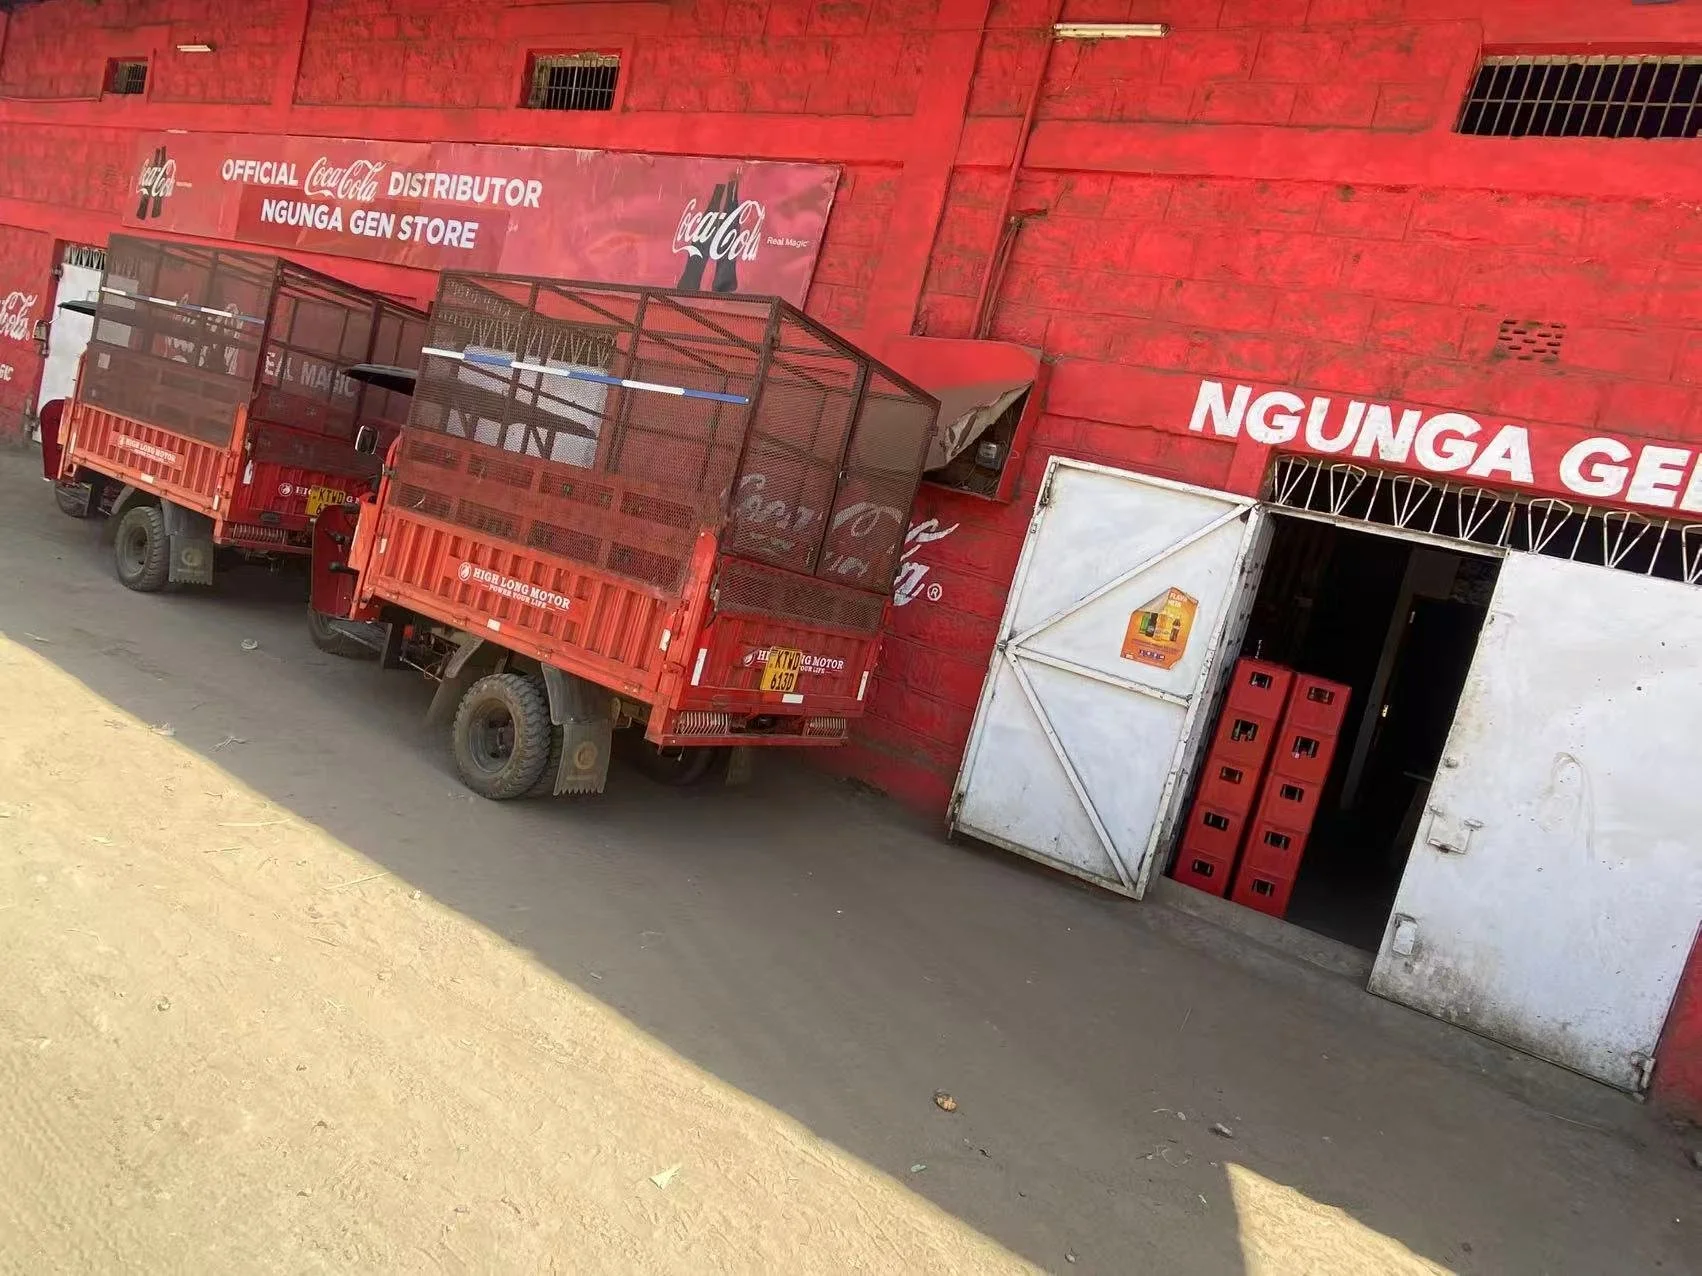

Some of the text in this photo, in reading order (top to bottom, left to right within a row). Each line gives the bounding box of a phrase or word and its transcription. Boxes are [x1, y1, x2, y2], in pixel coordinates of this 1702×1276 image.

[222, 156, 543, 208] OFFICIAL Coca-Cola DISTRIBUTOR
[261, 198, 479, 249] NGUNGA GEN STORE
[767, 236, 808, 248] Real Magic
[1188, 380, 1536, 484] NGUNGA
[473, 567, 571, 609] HIGH LONG MOTOR
[489, 583, 547, 609] POWER YOUR LIFE
[757, 650, 770, 661] HI
[813, 656, 844, 670] MOTOR
[774, 649, 801, 671] KTWD
[799, 665, 813, 673] OUR
[770, 671, 795, 691] 613D
